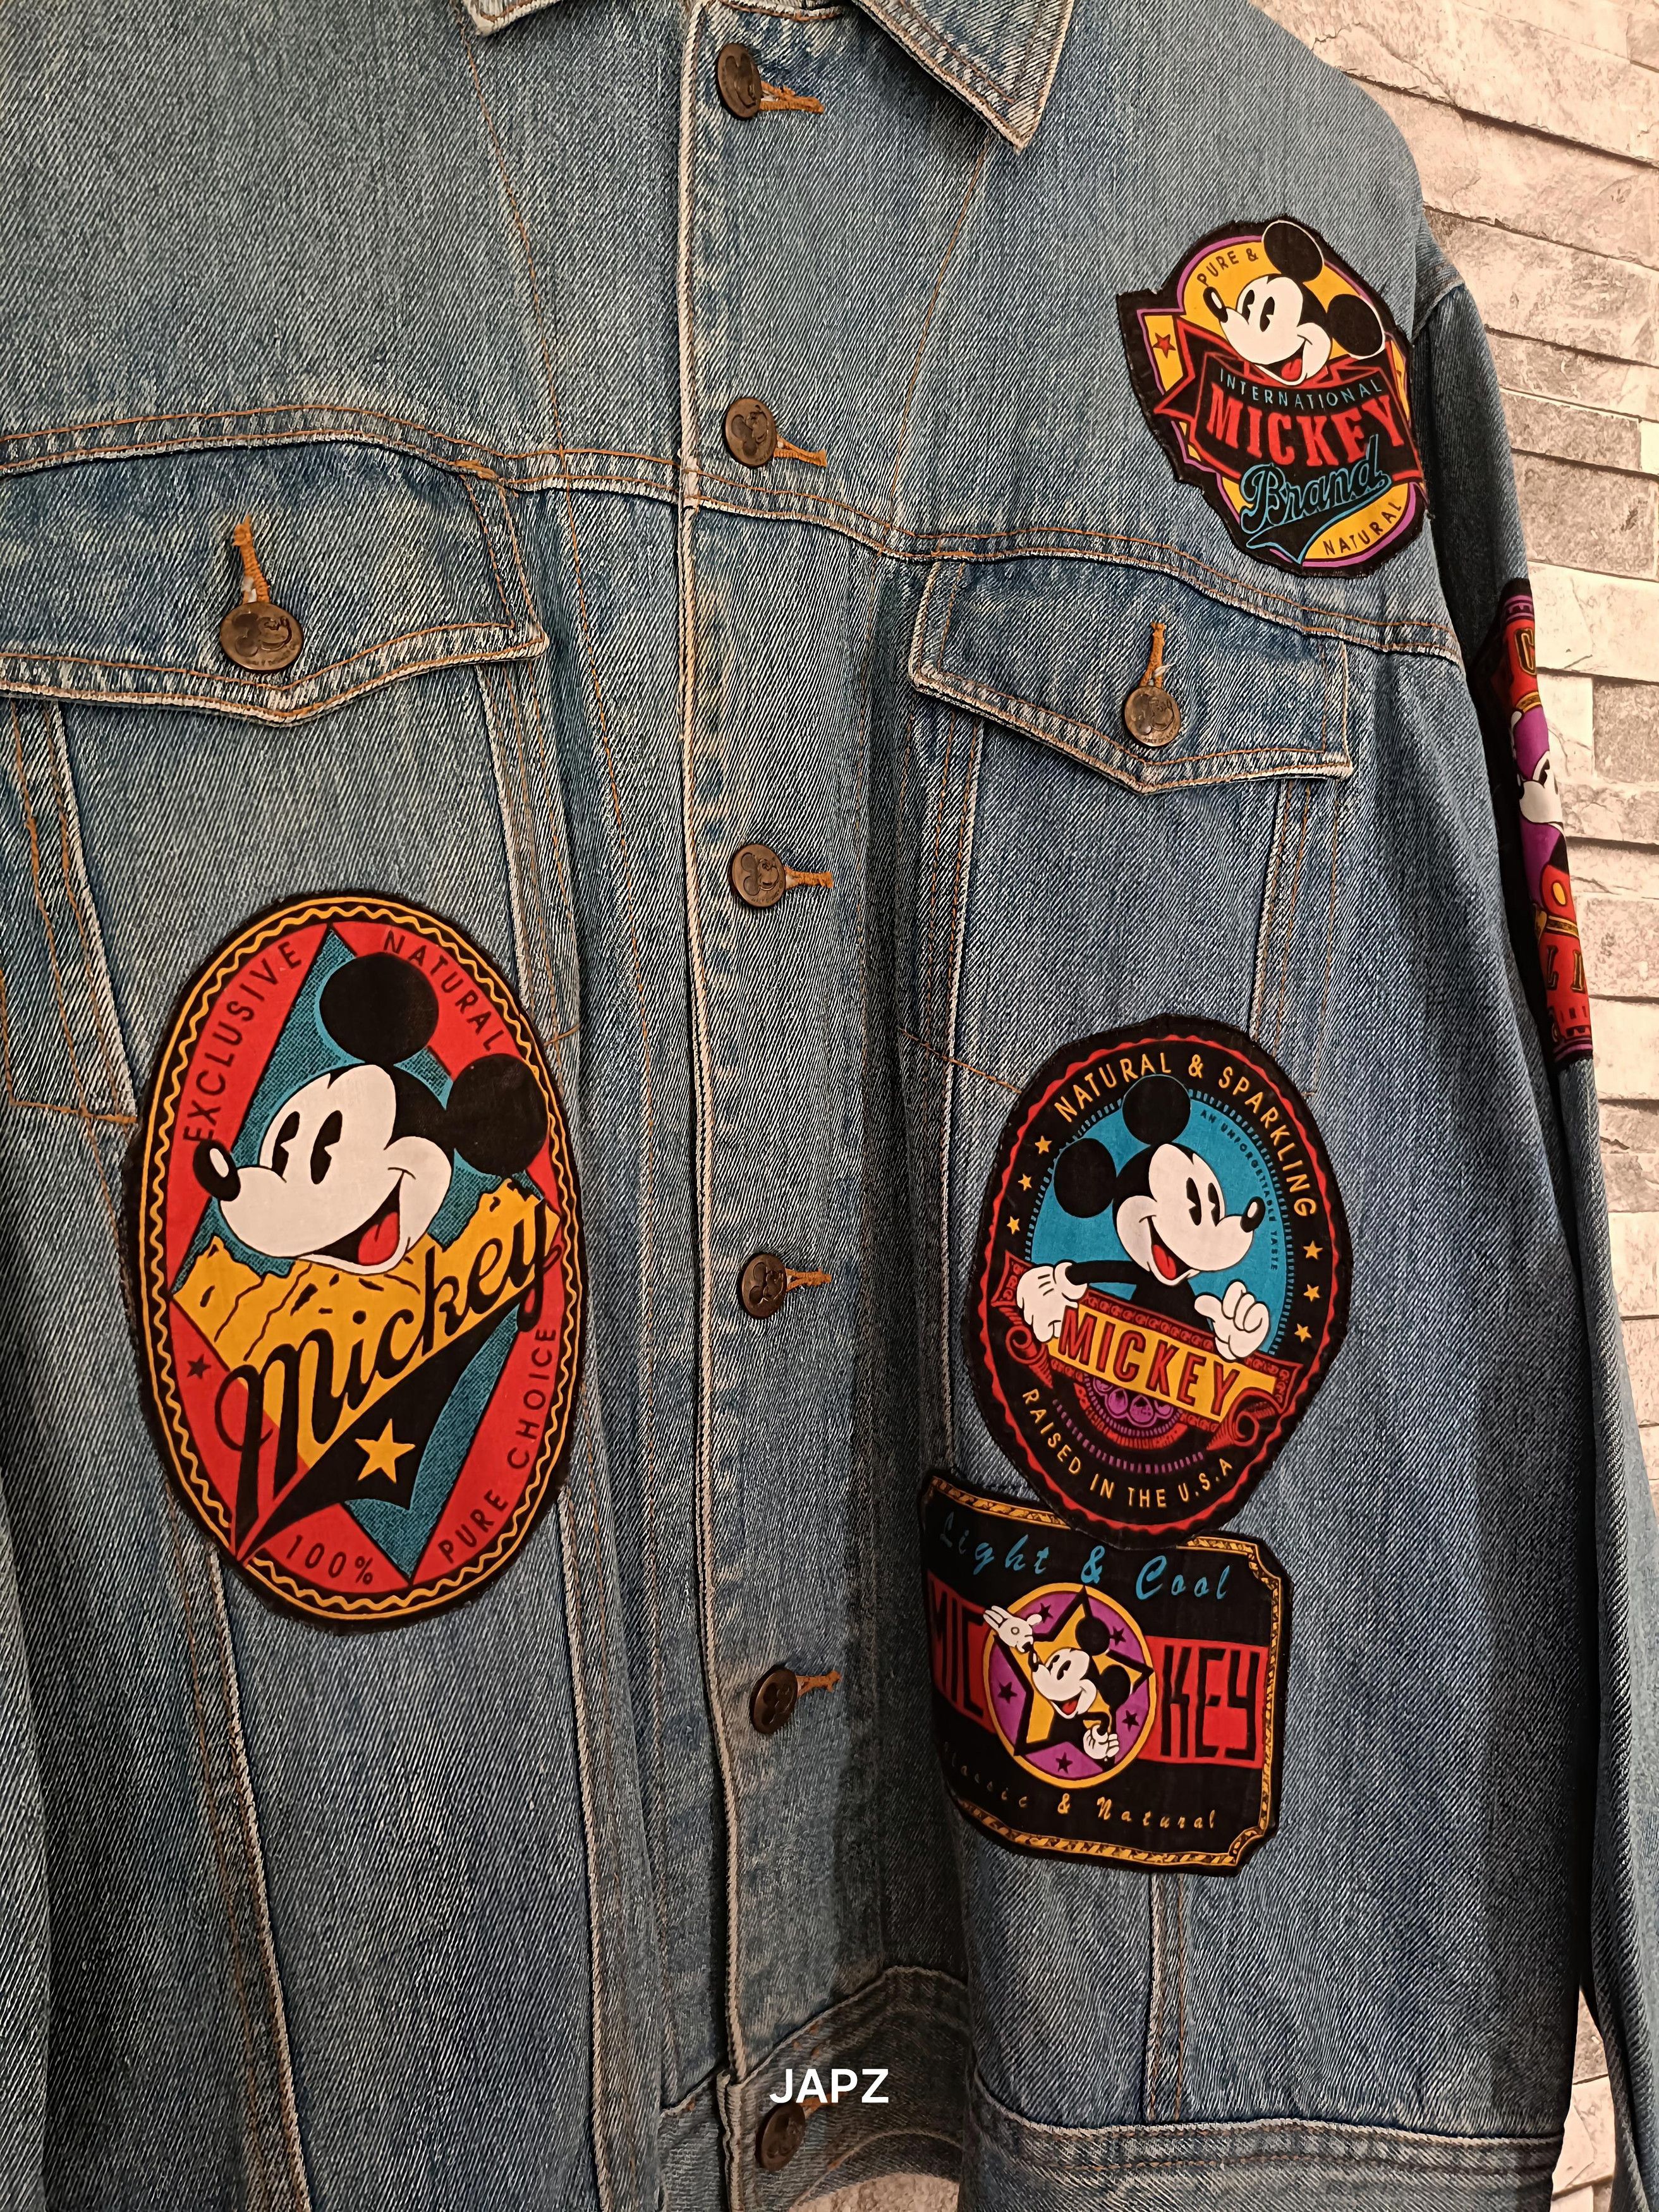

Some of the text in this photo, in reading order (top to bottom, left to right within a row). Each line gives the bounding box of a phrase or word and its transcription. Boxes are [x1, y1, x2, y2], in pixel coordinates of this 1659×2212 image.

[1197, 247, 1260, 287] PURE &
[1206, 381, 1404, 467] MICKEY
[1220, 367, 1382, 411] INTERNATIONAL
[1240, 434, 1392, 535] Brand
[1322, 501, 1403, 556] NATURAL
[182, 940, 303, 1143] EXCLUSIVE
[382, 930, 504, 1052] NATURAL
[1054, 1052, 1317, 1218] NATURAL & SPARKLING
[1200, 1109, 1217, 1124] AN
[1270, 1230, 1279, 1271] TASTE
[214, 1196, 563, 1553] Mickey
[1057, 1306, 1241, 1418] MICKEY
[437, 1327, 557, 1564] PURE CHOICE
[1021, 1387, 1234, 1509] RAISED IN THE U.S.A
[286, 1533, 375, 1586] 100%
[939, 1511, 1231, 1601] Light & Cool
[1057, 1792, 1072, 1815] &
[1097, 1796, 1218, 1831] Natural
